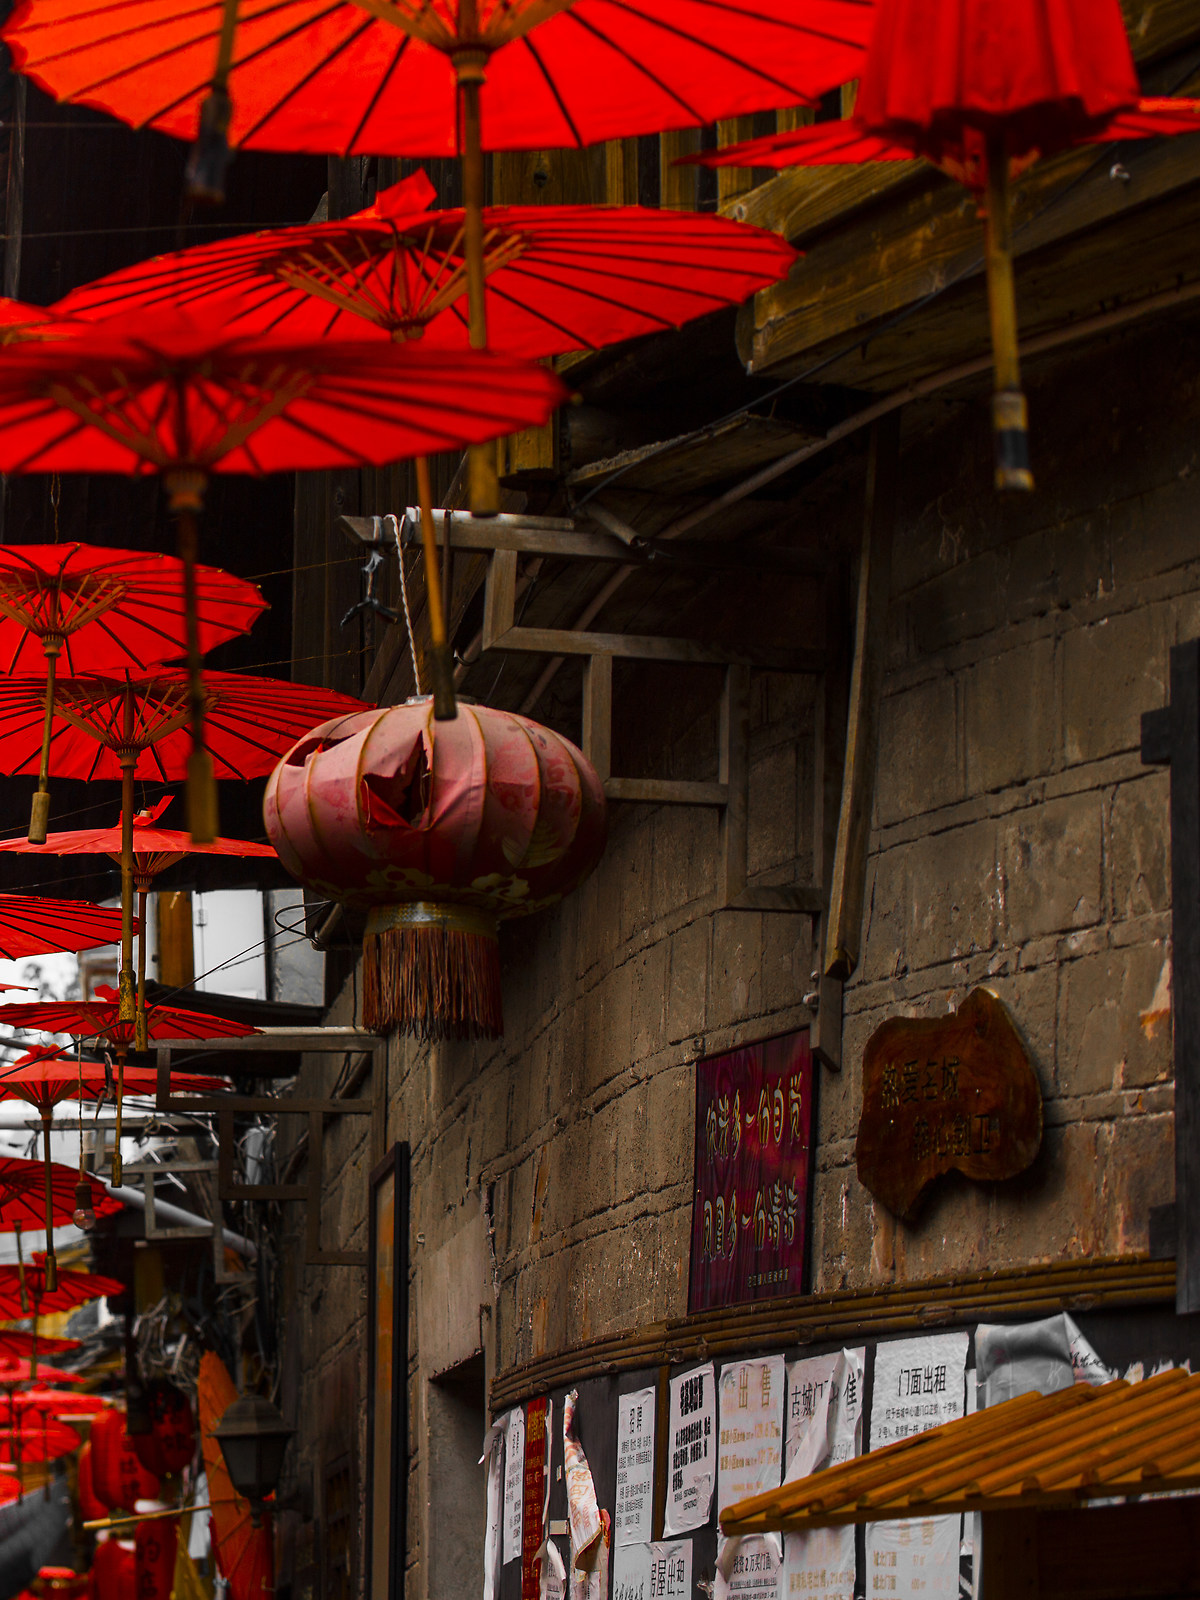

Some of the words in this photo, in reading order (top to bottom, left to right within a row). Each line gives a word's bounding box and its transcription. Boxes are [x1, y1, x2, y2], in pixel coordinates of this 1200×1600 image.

[738, 1364, 772, 1410] 出售
[898, 1365, 947, 1397] 门面出租
